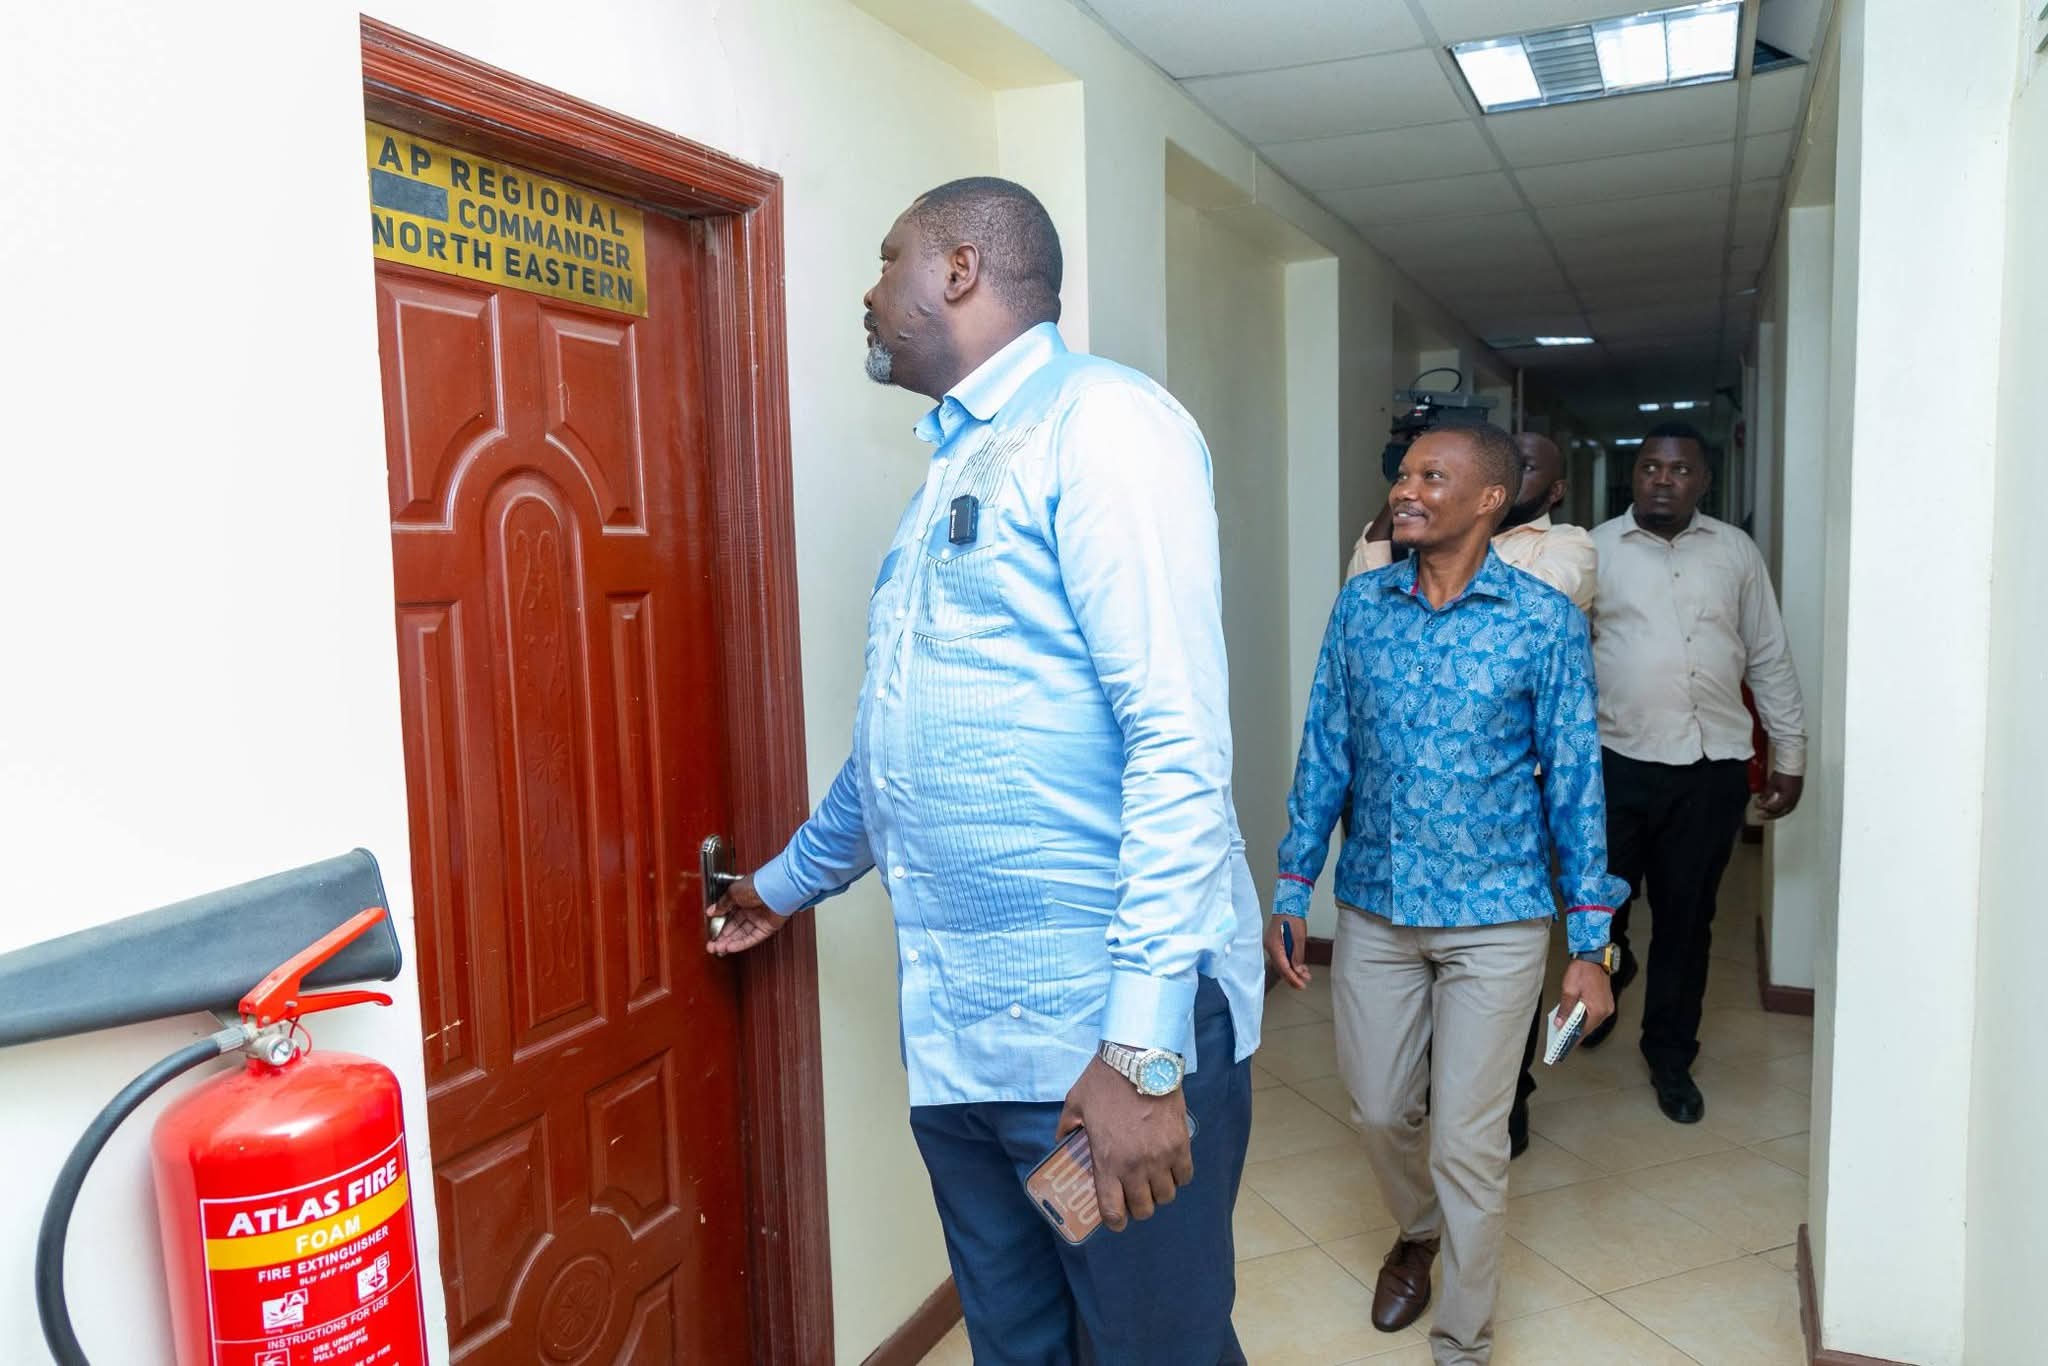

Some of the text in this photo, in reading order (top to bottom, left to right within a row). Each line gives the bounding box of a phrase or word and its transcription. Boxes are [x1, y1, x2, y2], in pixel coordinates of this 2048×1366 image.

[378, 136, 625, 237] AP REGIONAL
[372, 212, 633, 304] NORTH EASTERN
[458, 199, 632, 272] COMMANDER
[227, 1157, 398, 1237] ATLAS FIRE
[257, 1225, 389, 1284] FIRE EXTINGUISHER
[296, 1215, 361, 1254] FOAM
[339, 1256, 362, 1272] FOAM
[377, 1256, 388, 1271] B
[286, 1292, 304, 1306] A
[268, 1319, 347, 1350] INSTRUCTIONS
[351, 1308, 370, 1324] FOR
[373, 1296, 389, 1312] USE
[312, 1326, 366, 1354] USE UPRIGHT
[313, 1334, 369, 1363] PULL OUT PIN
